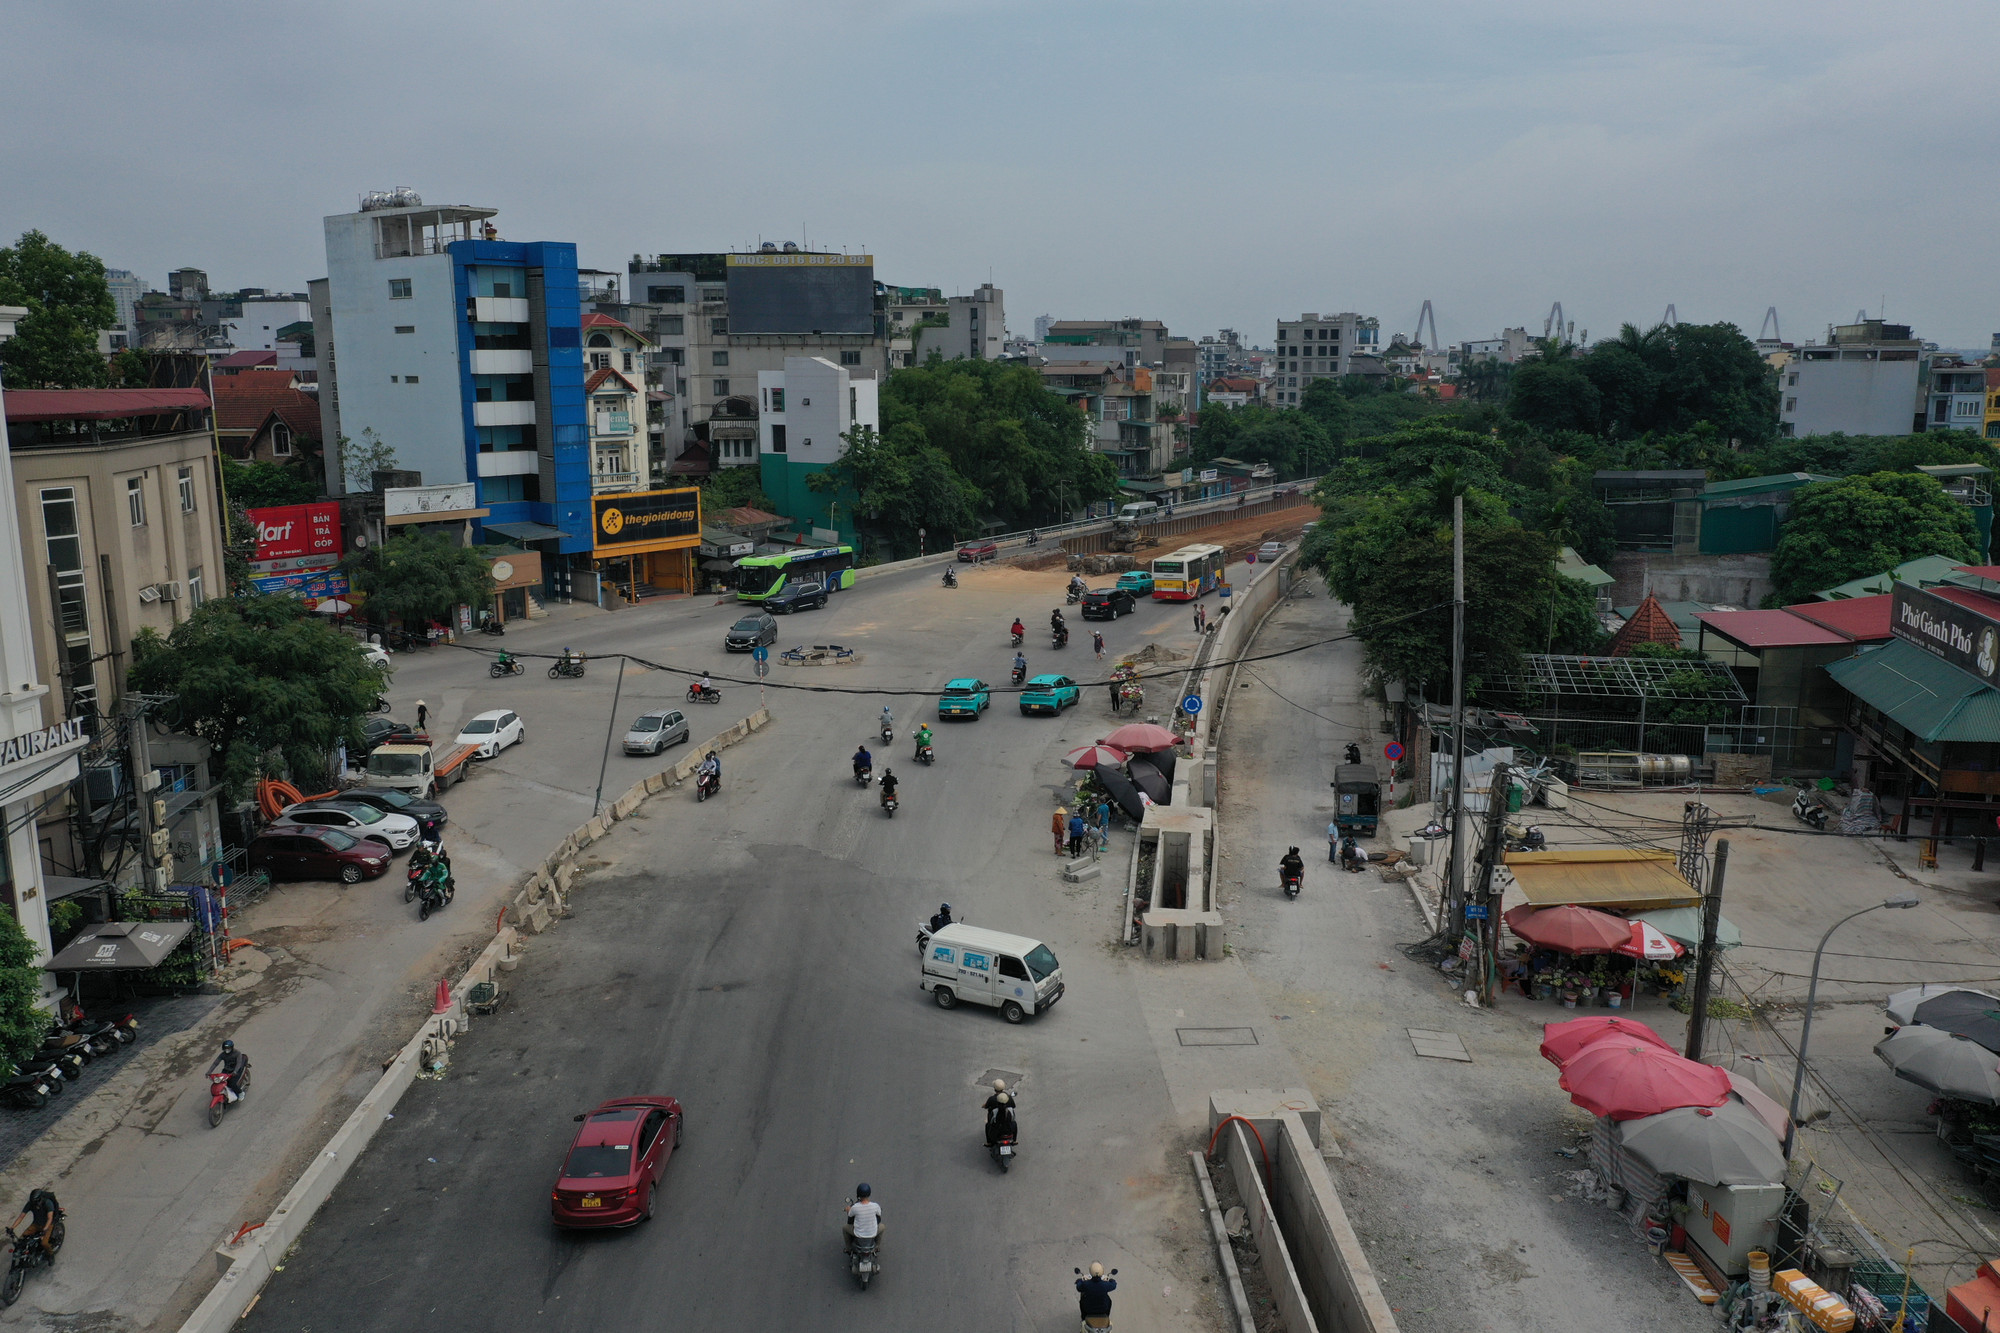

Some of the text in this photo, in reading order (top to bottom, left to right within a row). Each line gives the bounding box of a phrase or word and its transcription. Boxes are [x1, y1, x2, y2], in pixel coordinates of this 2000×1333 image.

[735, 255, 866, 266] MQC: 0916 80 20 99
[313, 512, 330, 523] BÁN
[624, 510, 695, 526] thegioididong
[314, 537, 333, 547] GÓP
[1901, 602, 1920, 629] Phở
[1920, 611, 1948, 643] Gánh
[1950, 623, 1973, 654] Phố
